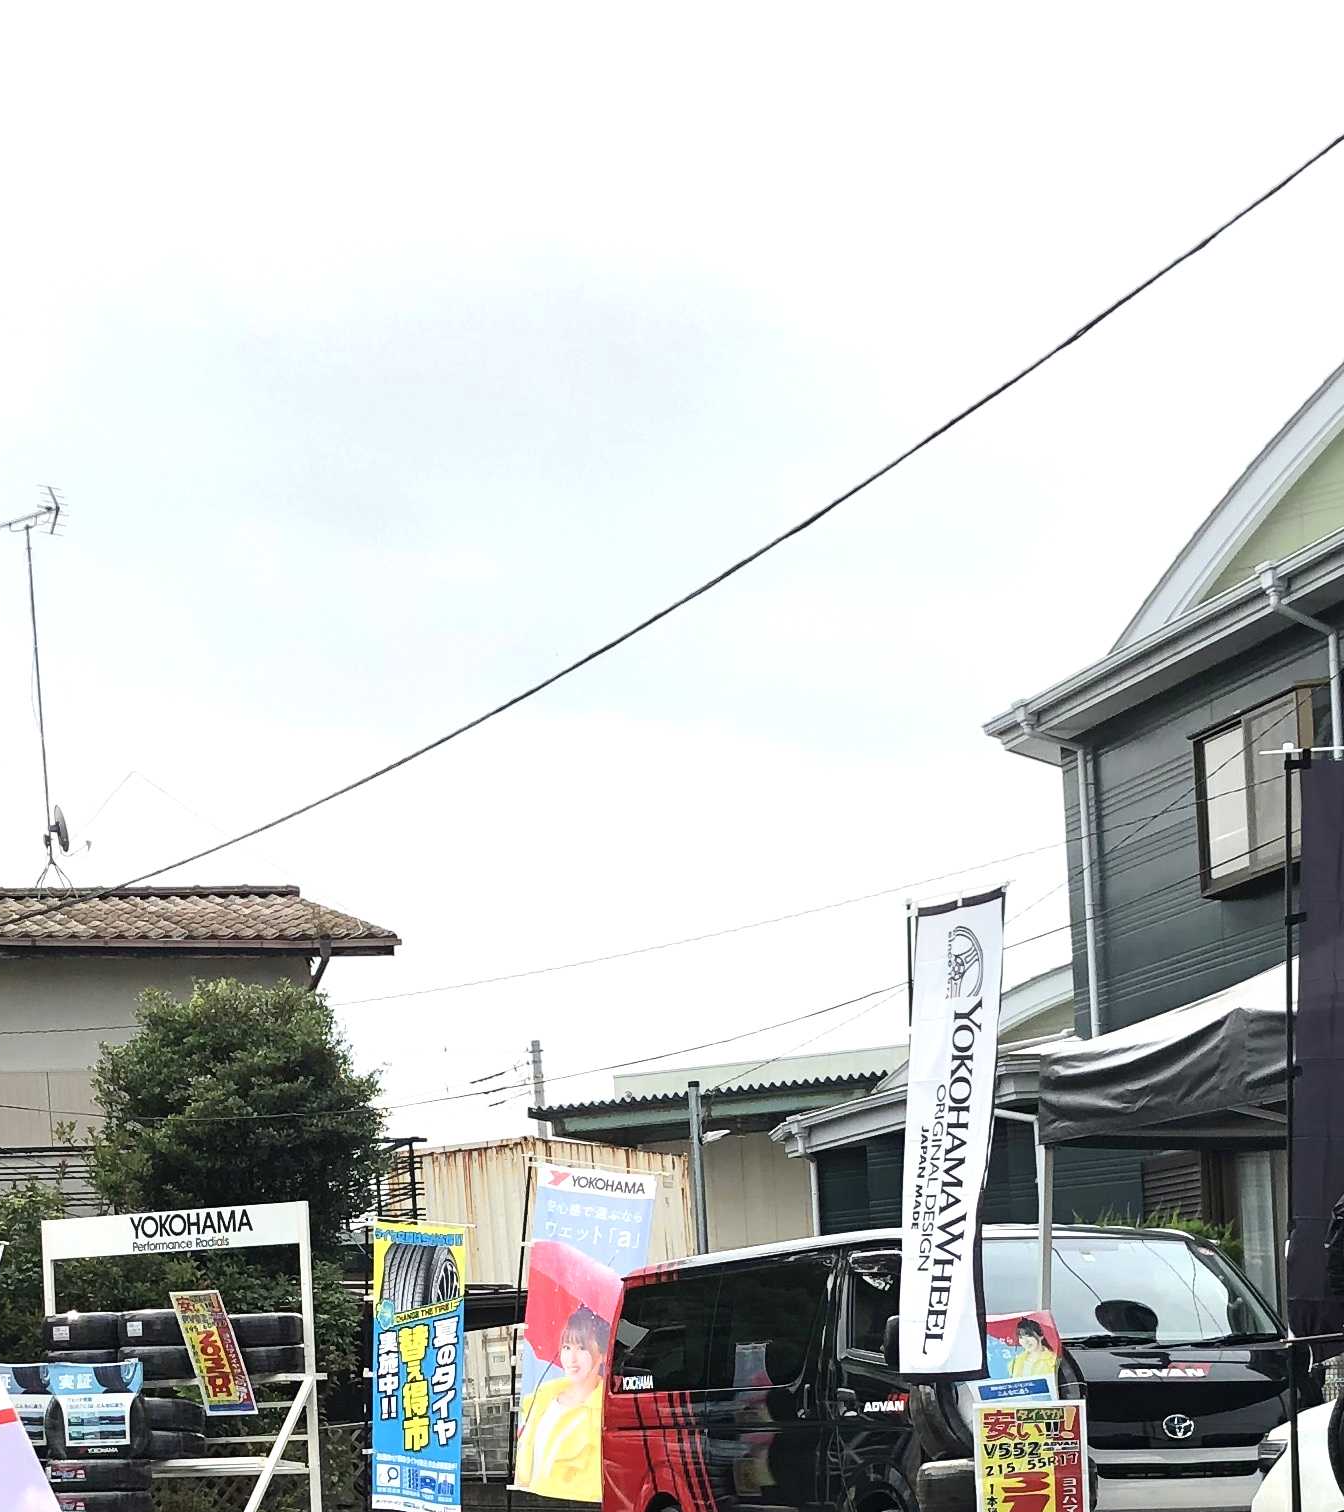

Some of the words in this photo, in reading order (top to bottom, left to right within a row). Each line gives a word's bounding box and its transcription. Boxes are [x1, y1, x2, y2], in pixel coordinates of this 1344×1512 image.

[926, 1083, 947, 1189] ORIGINAL
[916, 1126, 930, 1179] JAPAN
[571, 1175, 646, 1195] YOKOHAMA
[910, 1184, 923, 1230] MADE
[129, 1208, 254, 1240] YOKOHAMA
[916, 1194, 937, 1272] DESIGN
[132, 1240, 193, 1253] Performance
[195, 1236, 230, 1248] Radials
[431, 1315, 461, 1446] 夏のタイヤ
[1117, 1368, 1207, 1378] ADVAN
[863, 1400, 905, 1412] ADVAN
[983, 1441, 1041, 1460] V552
